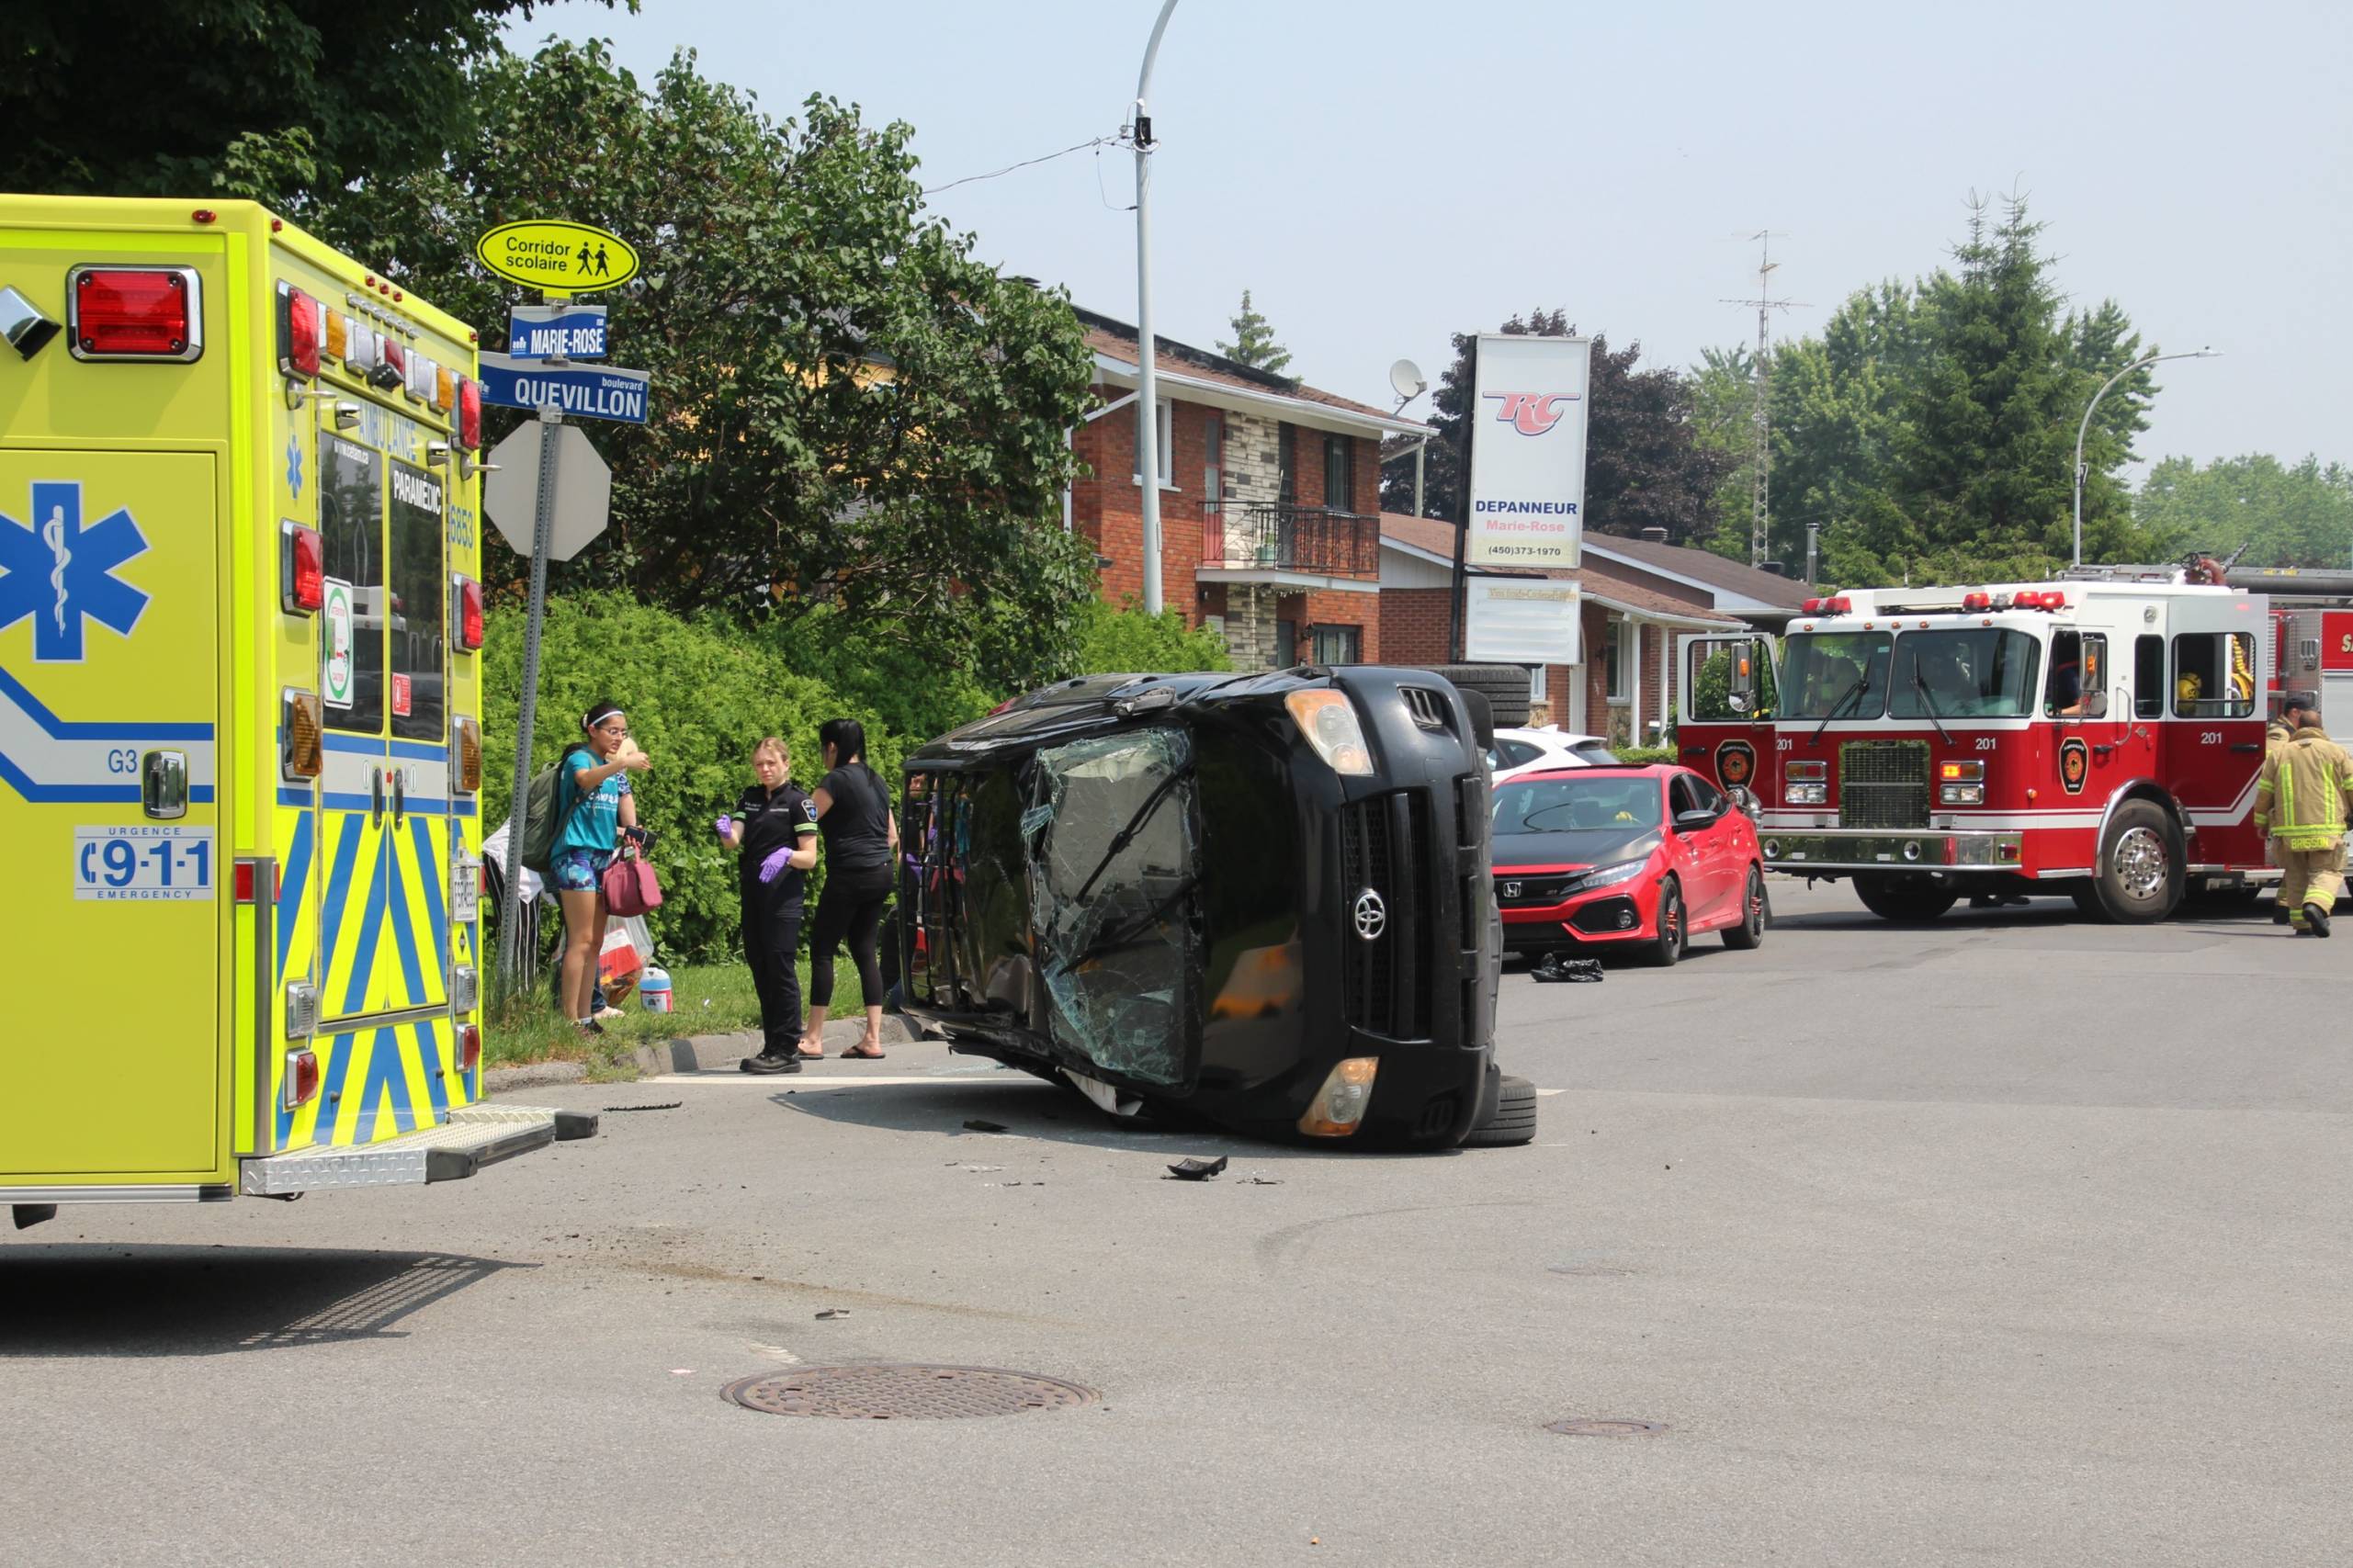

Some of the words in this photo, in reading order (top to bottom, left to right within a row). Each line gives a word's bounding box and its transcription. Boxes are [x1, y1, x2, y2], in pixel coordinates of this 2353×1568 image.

[506, 237, 571, 256] Corridor
[506, 254, 567, 272] scolaire
[531, 328, 603, 355] MARIE-ROSE
[602, 377, 643, 391] boulevard
[515, 378, 640, 418] QUEVILLON
[1483, 391, 1581, 437] RC
[393, 472, 441, 515] PARAMÉDIC
[1476, 500, 1578, 515] DEPANNEUR
[1486, 520, 1566, 533] Marie-Rose
[1488, 546, 1561, 557] (450)373-1970
[1776, 739, 1793, 750] 201
[1975, 738, 1997, 750] 201
[2201, 732, 2223, 744] 201
[107, 749, 138, 773] G3
[108, 828, 182, 836] URGENCE
[2291, 837, 2329, 851] BRISSON
[103, 839, 209, 887] 9-1-1
[97, 890, 192, 898] EMERGENCY
